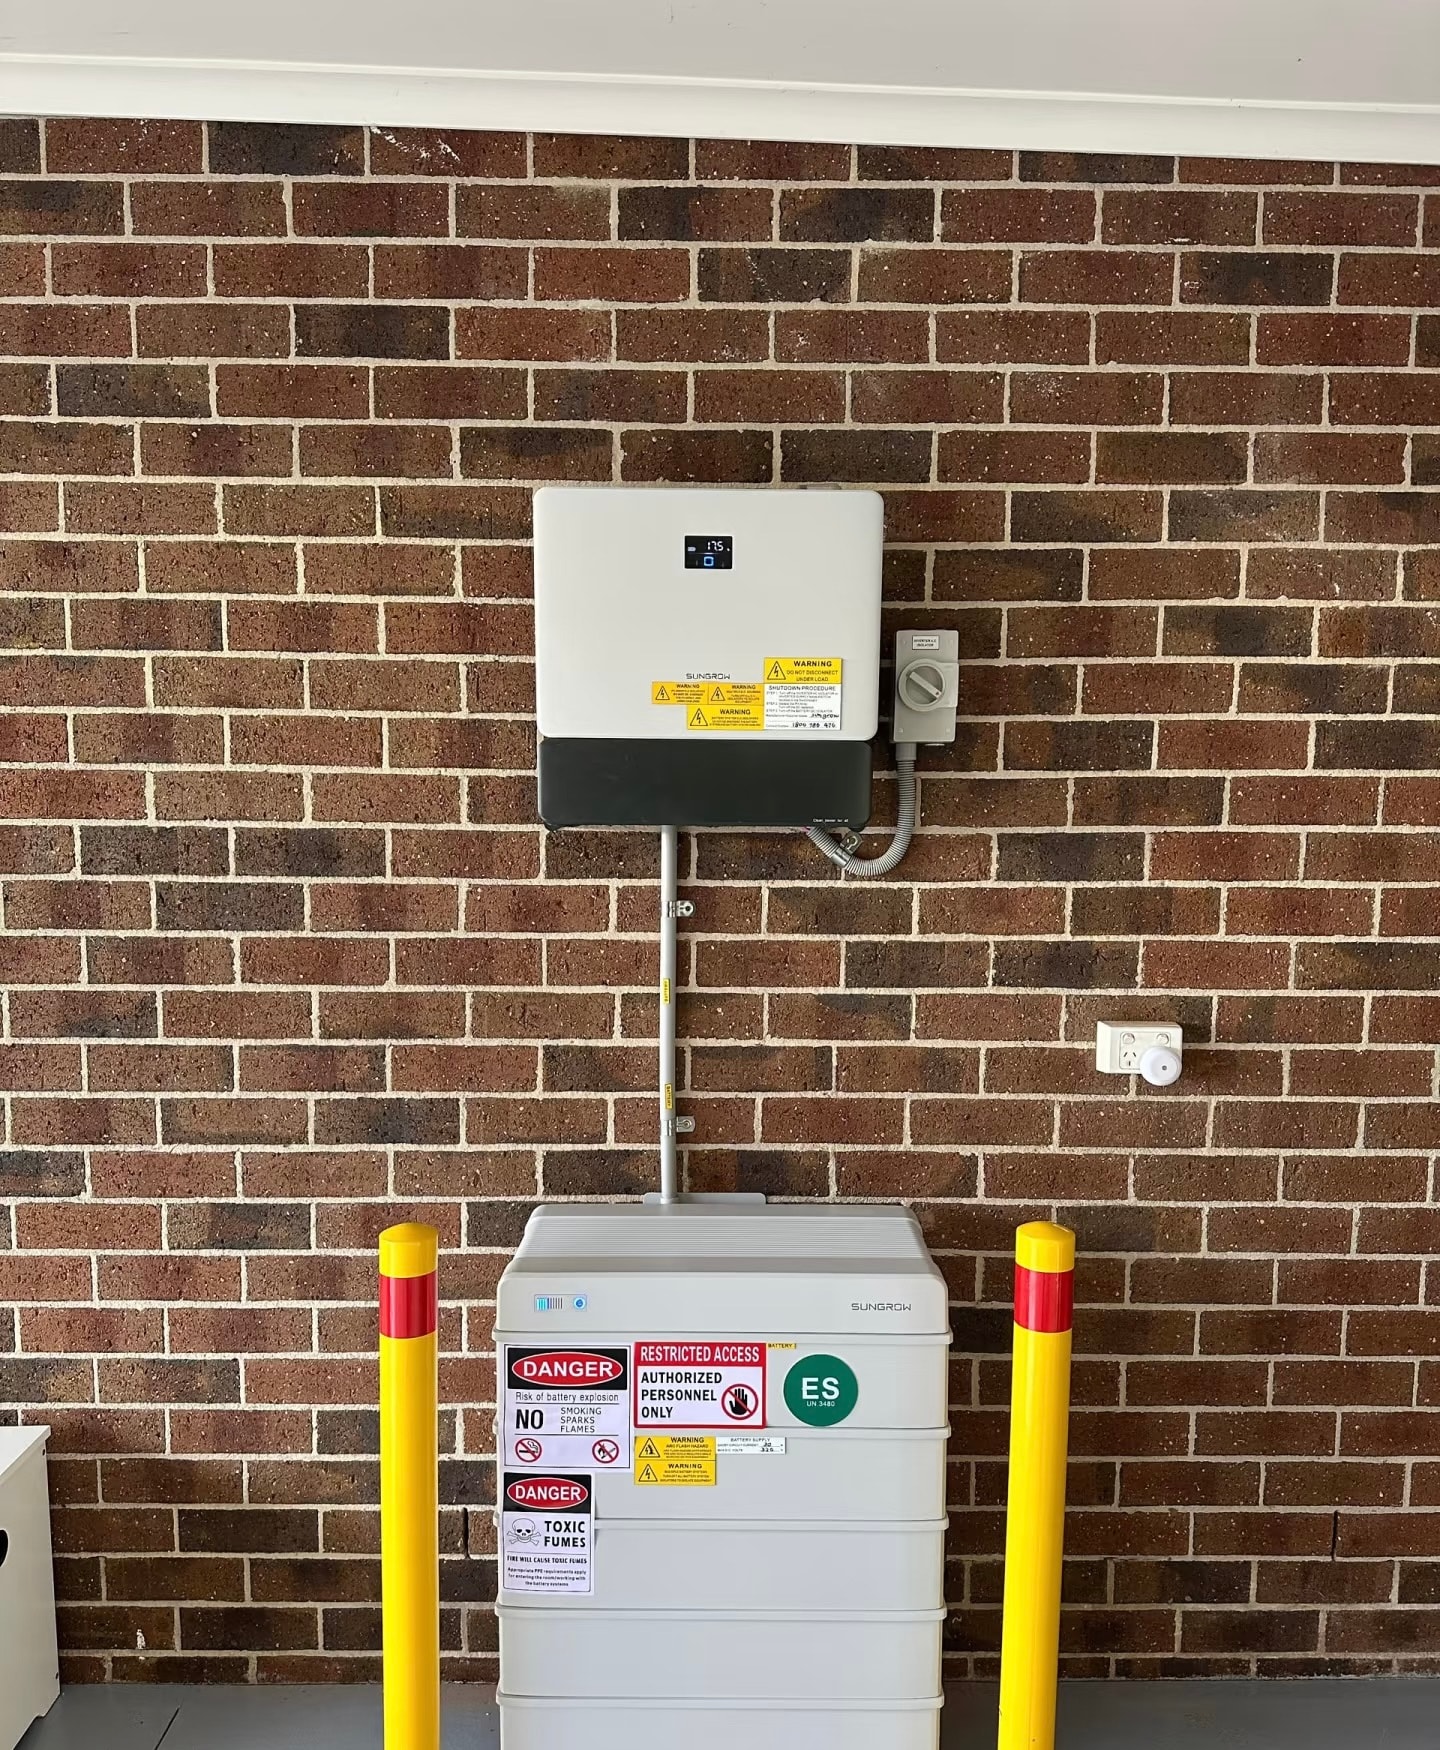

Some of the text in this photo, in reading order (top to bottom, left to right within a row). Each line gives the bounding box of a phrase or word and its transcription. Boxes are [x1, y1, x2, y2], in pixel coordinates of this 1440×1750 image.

[641, 1346, 759, 1362] RESTRICTED ACCESS
[523, 1361, 613, 1377] DANGER
[641, 1372, 722, 1384] AUTHORIZED
[802, 1377, 840, 1400] ES
[516, 1392, 618, 1403] Risk of battery explosion
[641, 1389, 717, 1401] PERSONNEL
[642, 1406, 673, 1418] ONLY
[516, 1409, 544, 1430] NO
[515, 1485, 581, 1501] DANGER
[544, 1521, 585, 1533] TOXIC
[544, 1536, 586, 1547] FUMES
